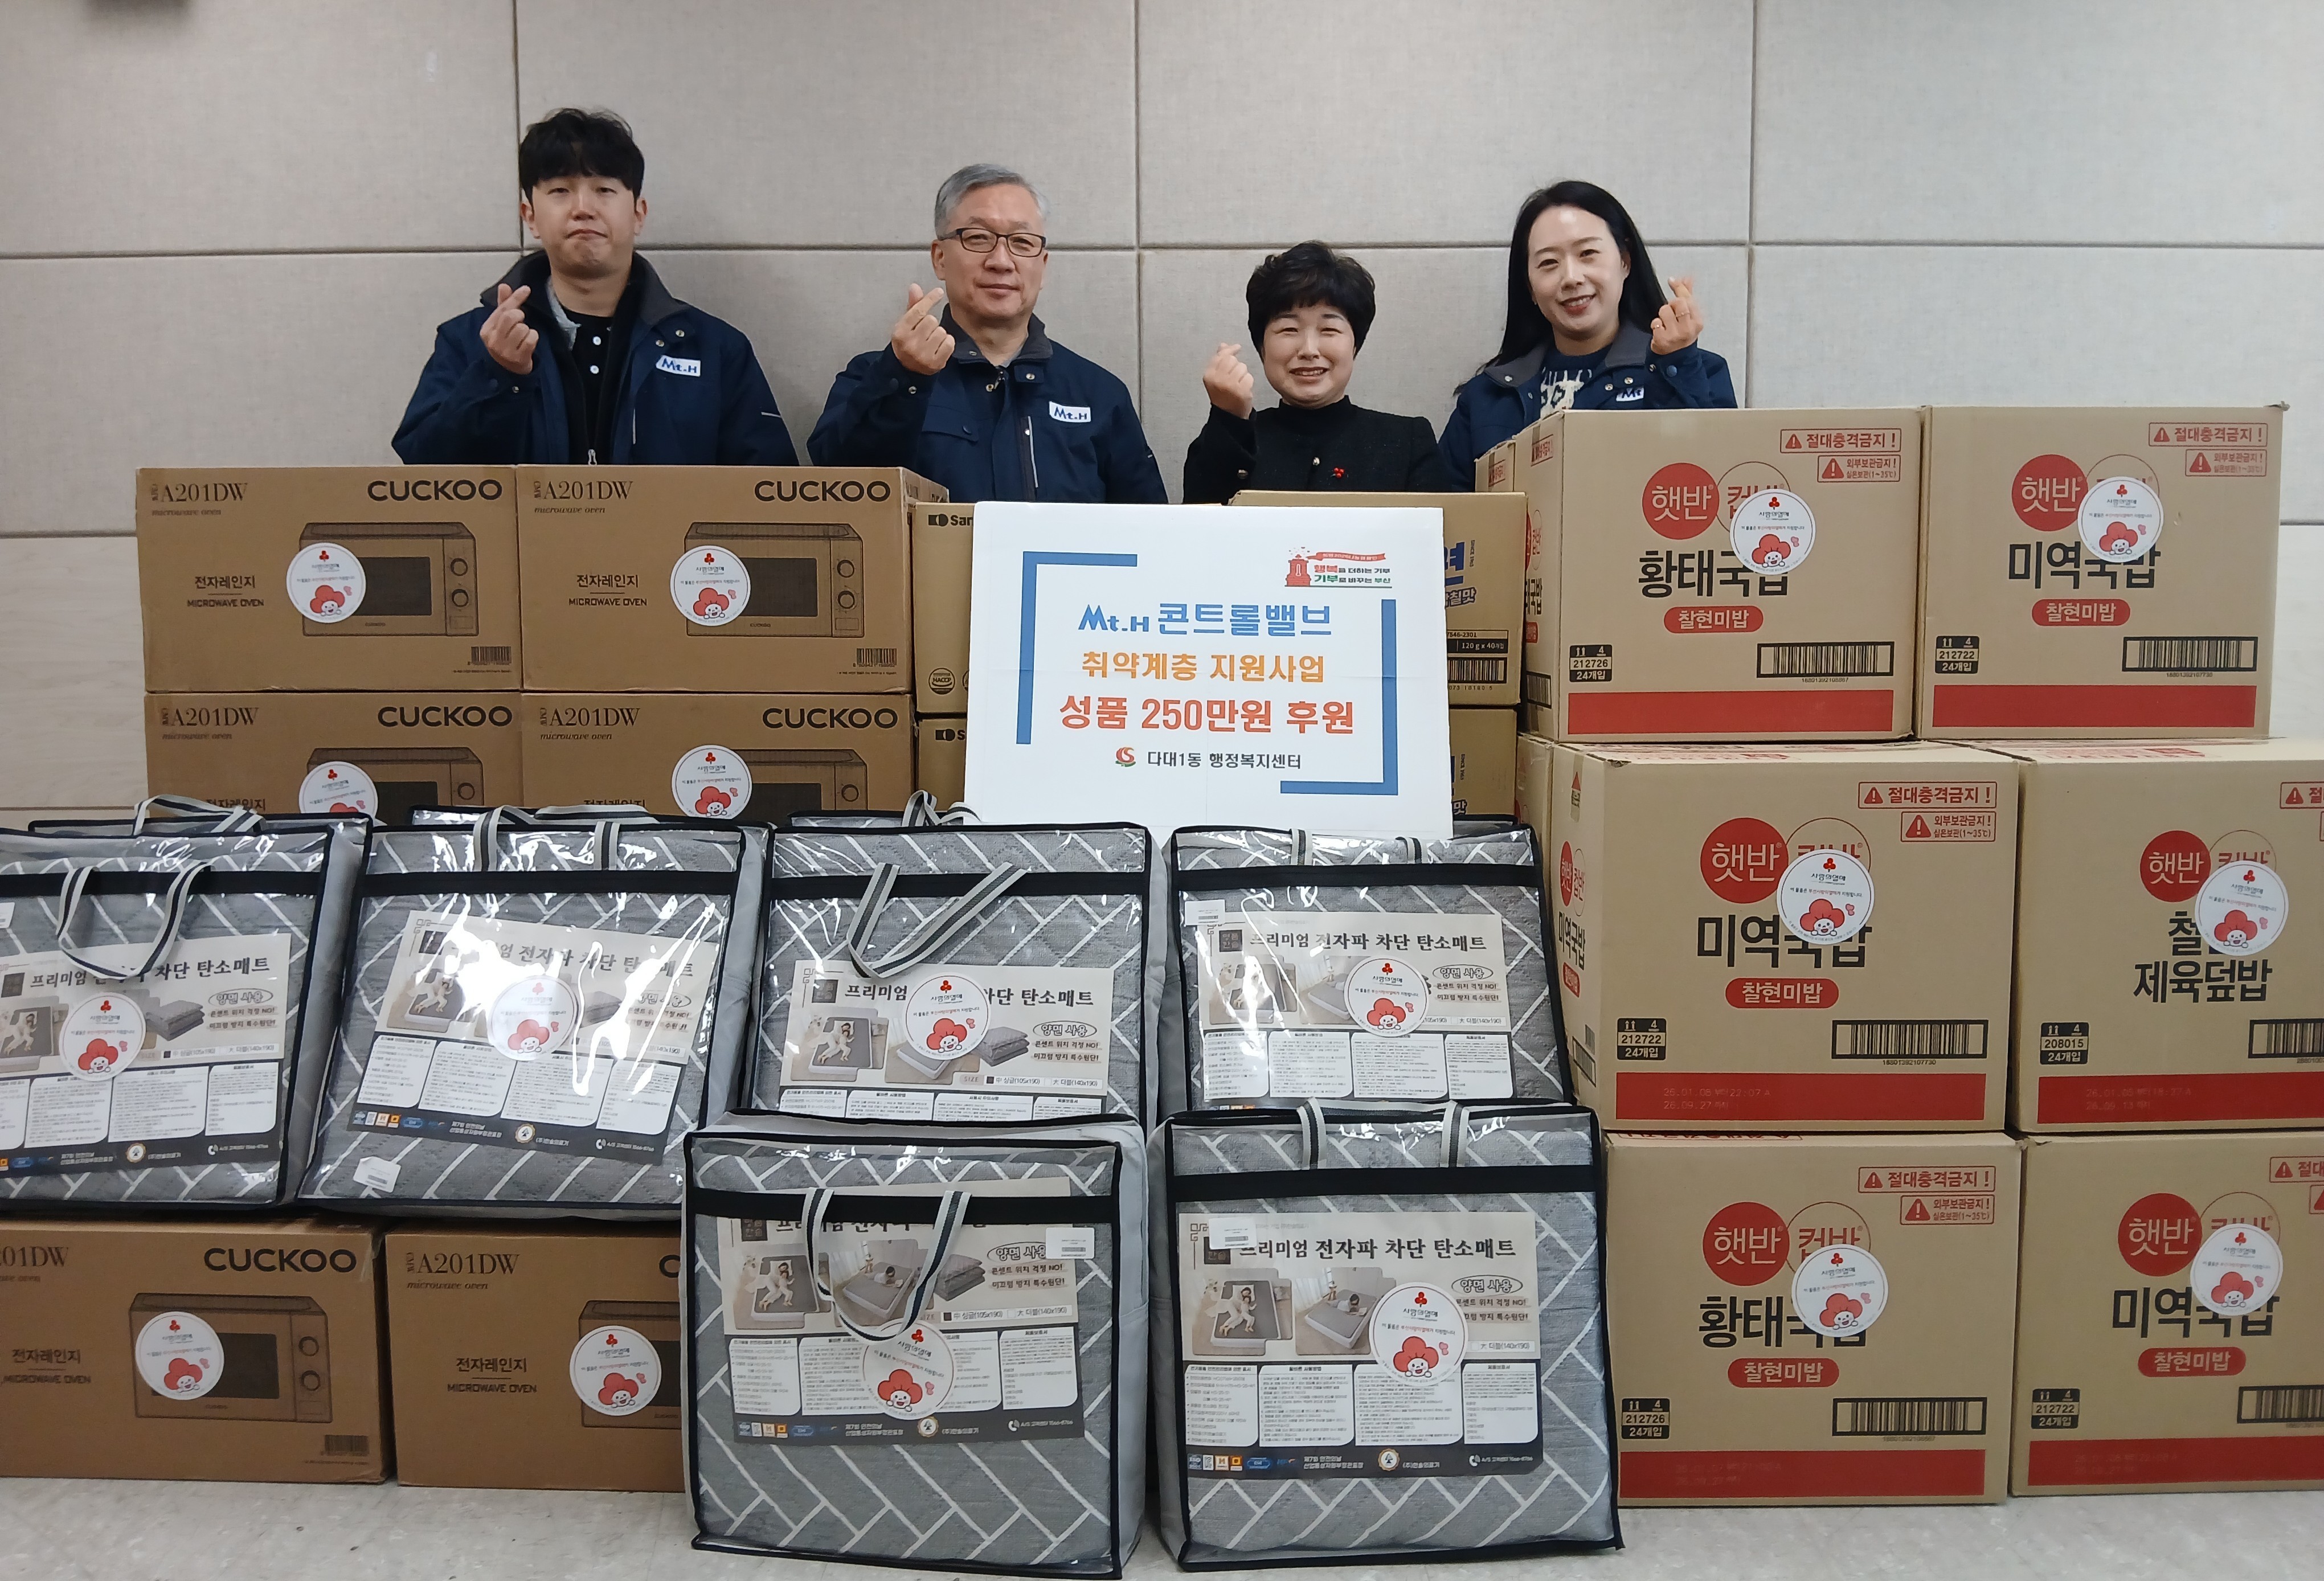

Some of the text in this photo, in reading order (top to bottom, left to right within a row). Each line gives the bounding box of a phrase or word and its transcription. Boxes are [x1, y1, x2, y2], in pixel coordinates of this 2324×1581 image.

[1807, 433, 1885, 448] 절대충격금지
[2175, 427, 2252, 442] 절대충격금지
[1847, 458, 1891, 468] 외부보관금지
[367, 479, 502, 501] CUCKOO
[544, 481, 633, 499] A201DW
[755, 480, 891, 502] CUCKOO
[2022, 477, 2080, 513] 햇반
[1652, 485, 1712, 521] 햇반
[195, 575, 256, 589] 전자레인지
[576, 574, 639, 588] 전자레인지
[187, 599, 264, 608] MICROWAVE OVEN
[1078, 602, 1332, 637] Mt.H 콘트롤밸브
[1677, 609, 1749, 629] 찰현미밥
[2046, 603, 2116, 623] 찰현미밥
[1939, 650, 1975, 660] 212722
[1082, 652, 1325, 683] 취약계층 지원사업
[1573, 659, 1609, 668] 212726
[1942, 662, 1972, 672] 24개입
[1576, 670, 1606, 681] 24개입
[378, 706, 512, 728] CUCKOO
[549, 707, 640, 726] A201DW
[762, 708, 898, 728] CUCKOO
[1060, 695, 1354, 734] 성품 250만원 후원
[1147, 751, 1302, 769] 다대1동 행정복지센터
[1888, 787, 1978, 803] 절대충격금지
[1934, 816, 1985, 826] 외부보관금지
[1712, 842, 1781, 882] 햇반
[2149, 851, 2204, 884] 햇반
[1250, 932, 1487, 951] 프리미엄 전자파 차단 탄소매트
[30, 970, 87, 988] 프리미엄
[197, 957, 270, 977] 탄소매트
[1440, 968, 1484, 978] 양면 사용
[2134, 959, 2272, 1003] 제육덮밥
[216, 992, 263, 1005] 양면 사용
[844, 985, 907, 1004] 프리미엄
[1021, 988, 1094, 1007] 탄소매트
[1742, 982, 1823, 1004] 찰현미밥
[1041, 1024, 1087, 1037] 양면 사용
[1621, 1034, 1662, 1045] 212722
[2044, 1038, 2084, 1048] 208015
[1625, 1047, 1658, 1059] 24개입
[2048, 1051, 2081, 1062] 24개입
[1888, 1172, 1977, 1188] 절대충격금지
[1933, 1198, 1983, 1209] 외부보관금지
[2129, 1218, 2194, 1256] 햇반
[1315, 1238, 1377, 1259] 전자파
[1386, 1239, 1426, 1259] 차단
[1434, 1238, 1516, 1259] 탄소매트
[1714, 1226, 1781, 1265] 햇반
[204, 1247, 357, 1272] CUCKOO
[996, 1247, 1020, 1261] 양면
[418, 1252, 519, 1275] A201DW
[1460, 1279, 1512, 1293] 양면 사용
[12, 1349, 81, 1364] 전자레인지
[2154, 1351, 2231, 1373] 찰현미밥
[456, 1358, 527, 1373] 전자레인지
[1744, 1362, 1823, 1383] 찰현미밥
[448, 1383, 537, 1393] MICROWAVE OVEN
[2035, 1404, 2075, 1414] 212722
[1626, 1414, 1665, 1424] 212726
[2039, 1416, 2072, 1427] 24개입
[1629, 1427, 1662, 1437] 24개입
